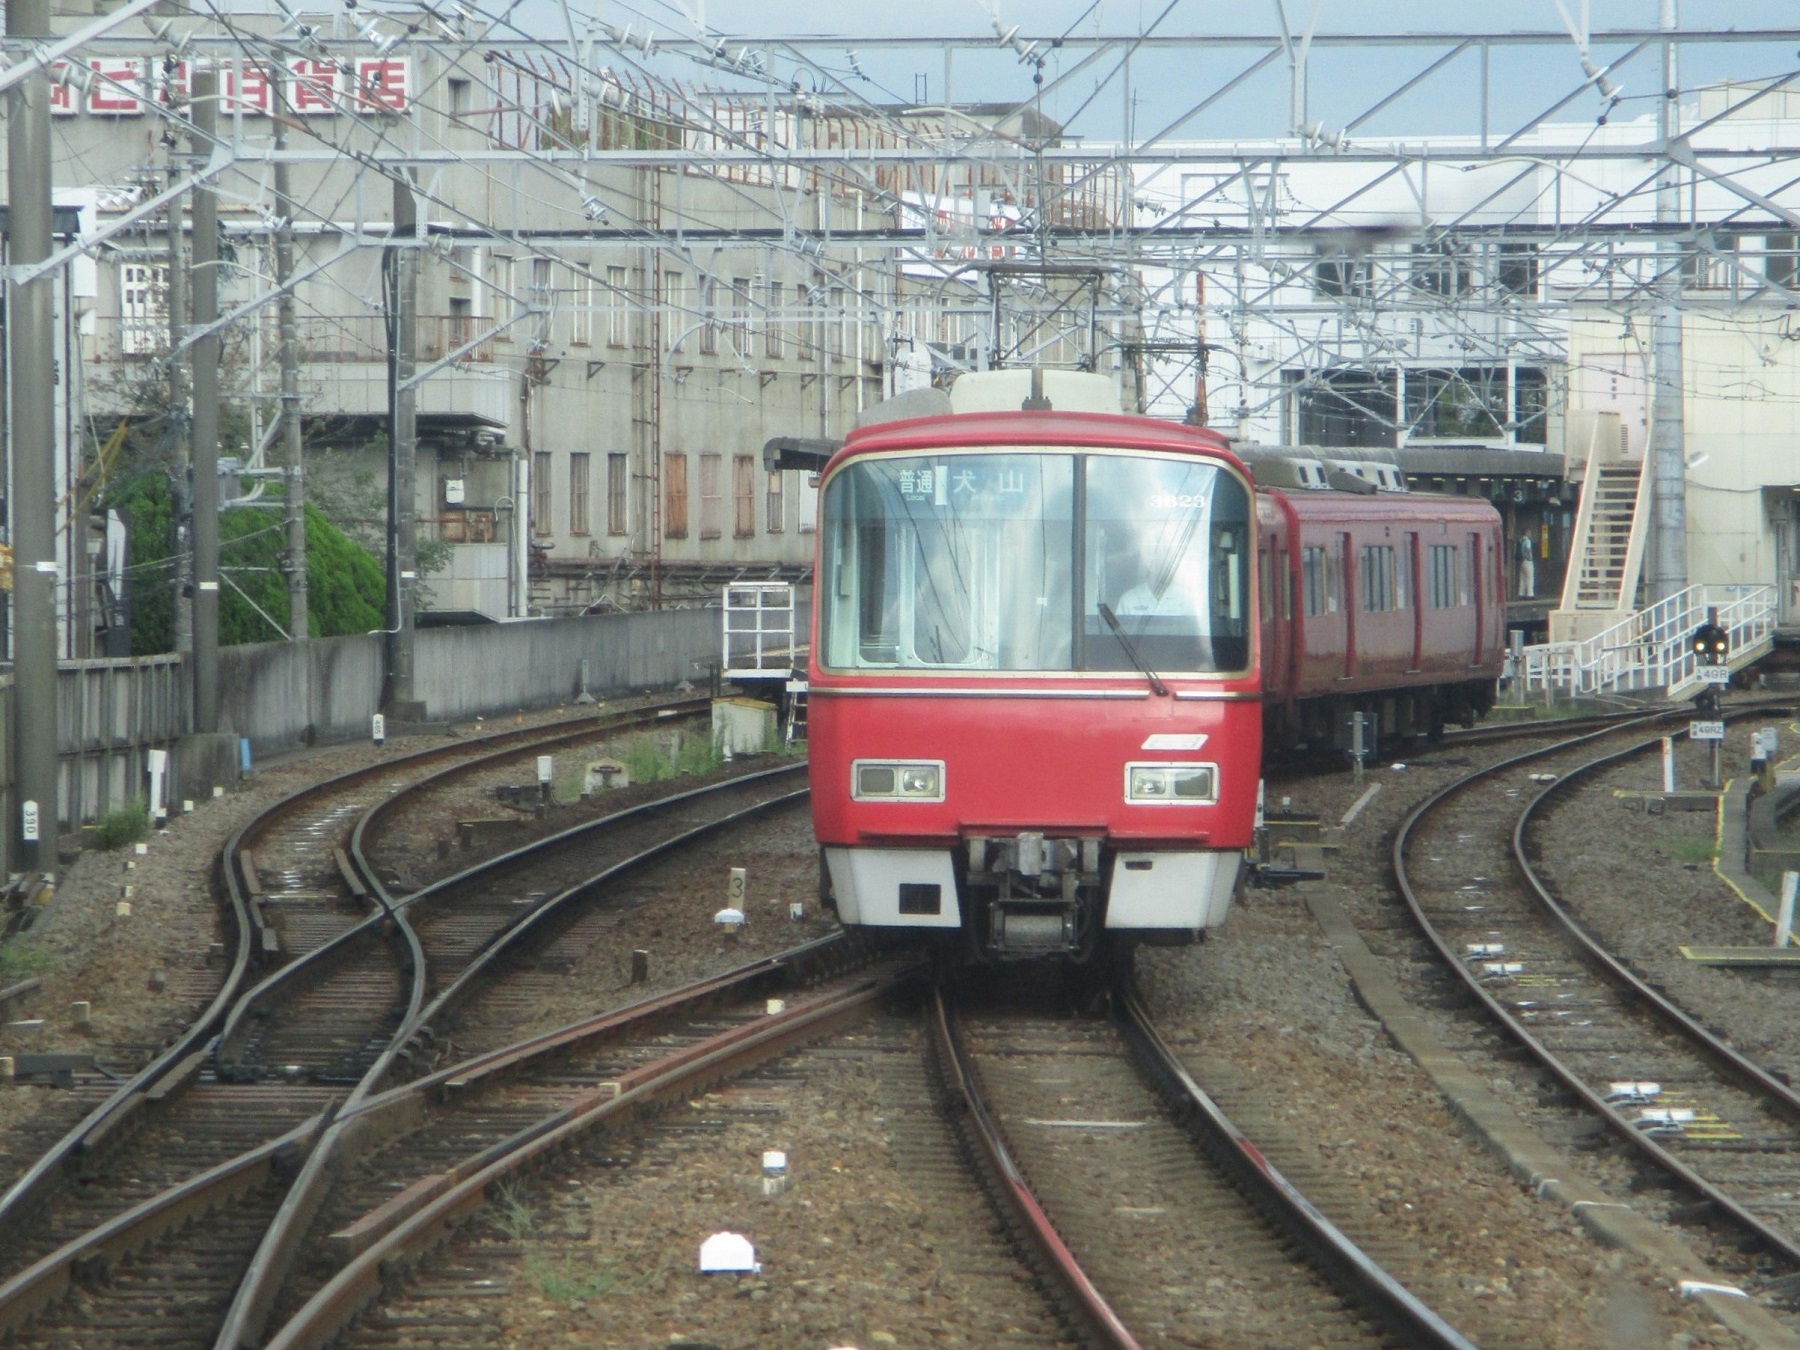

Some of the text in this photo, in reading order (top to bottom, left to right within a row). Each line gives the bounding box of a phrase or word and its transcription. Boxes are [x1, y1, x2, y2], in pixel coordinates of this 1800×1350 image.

[900, 469, 1024, 493] 普通 犬山
[1513, 490, 1522, 501] 3
[1704, 669, 1727, 679] 49R
[25, 810, 36, 833] 390
[732, 877, 743, 898] 3
